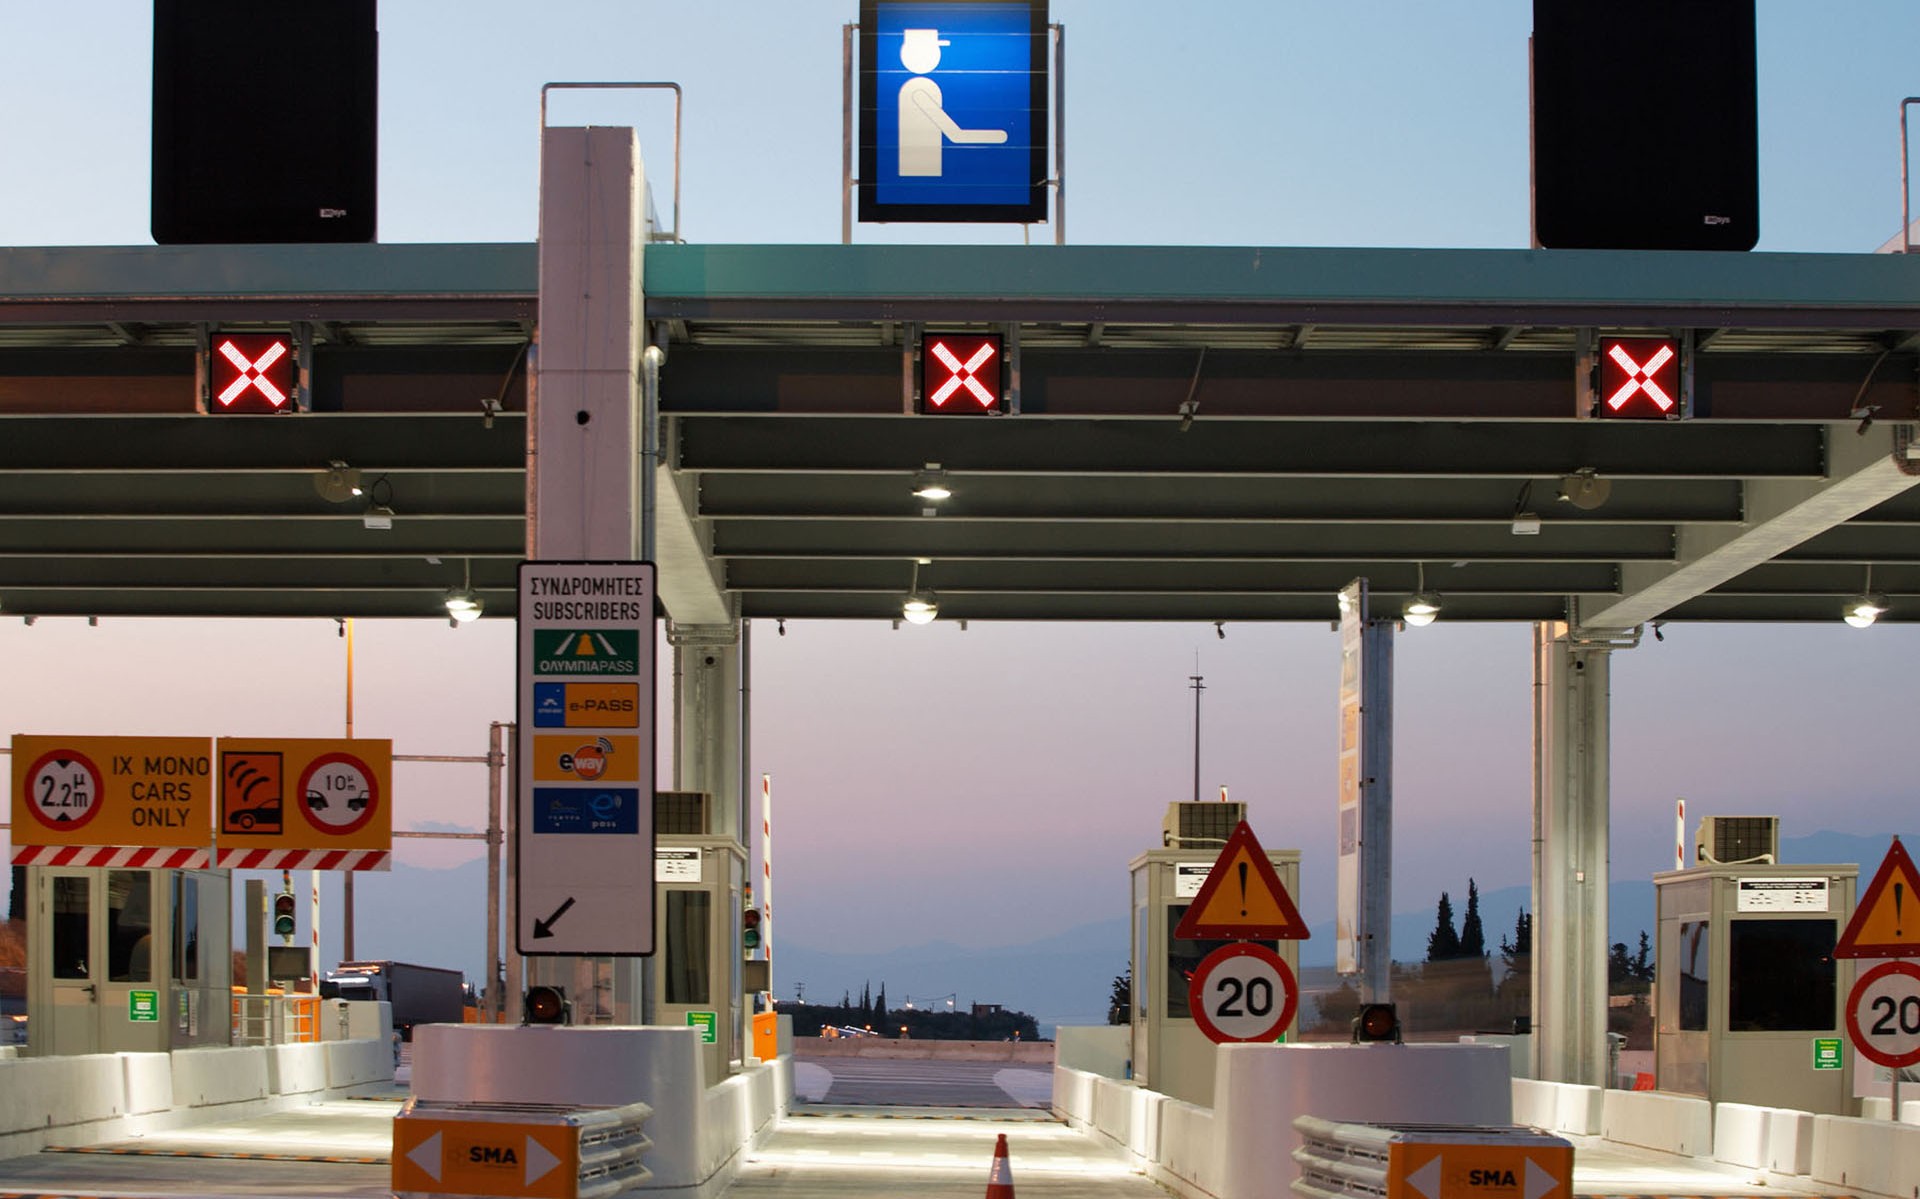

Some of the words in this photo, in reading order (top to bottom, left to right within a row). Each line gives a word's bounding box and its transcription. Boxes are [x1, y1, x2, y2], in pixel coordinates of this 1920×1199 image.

[531, 577, 643, 595] ΣΥΝΔΡΟΜΗΤΕΣ
[534, 602, 640, 620] SUBSCRIBERS
[570, 699, 634, 711] e-PASS
[131, 782, 192, 801] CARS
[132, 807, 191, 827] ONLY
[1216, 976, 1273, 1017] 20
[1871, 995, 1920, 1035] 20
[469, 1146, 518, 1164] SMA
[1469, 1170, 1517, 1186] SMA
